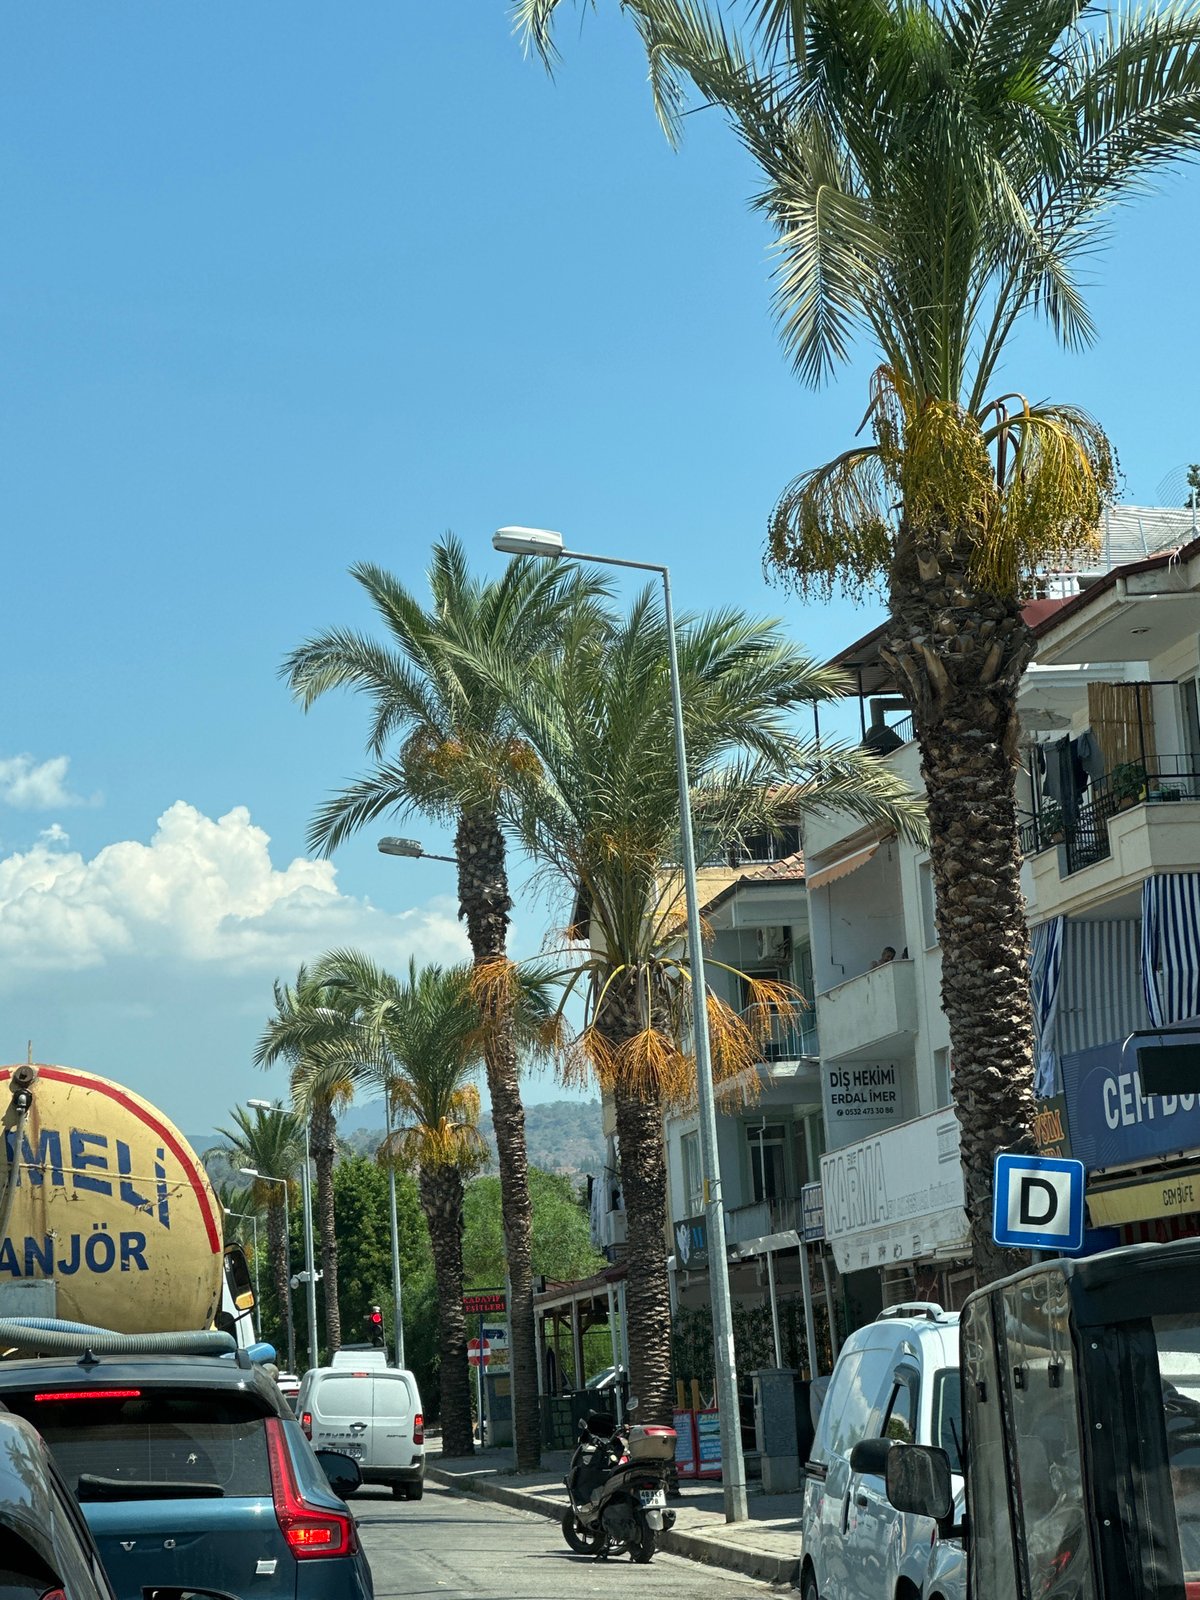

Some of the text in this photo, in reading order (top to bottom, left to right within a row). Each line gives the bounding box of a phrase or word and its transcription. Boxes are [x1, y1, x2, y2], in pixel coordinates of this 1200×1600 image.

[829, 1064, 895, 1091] DİŞ HEKİMİ
[831, 1089, 896, 1104] ERDAL İMER
[845, 1108, 861, 1116] 0532
[823, 1141, 890, 1235] KARMA
[1020, 1176, 1059, 1226] D
